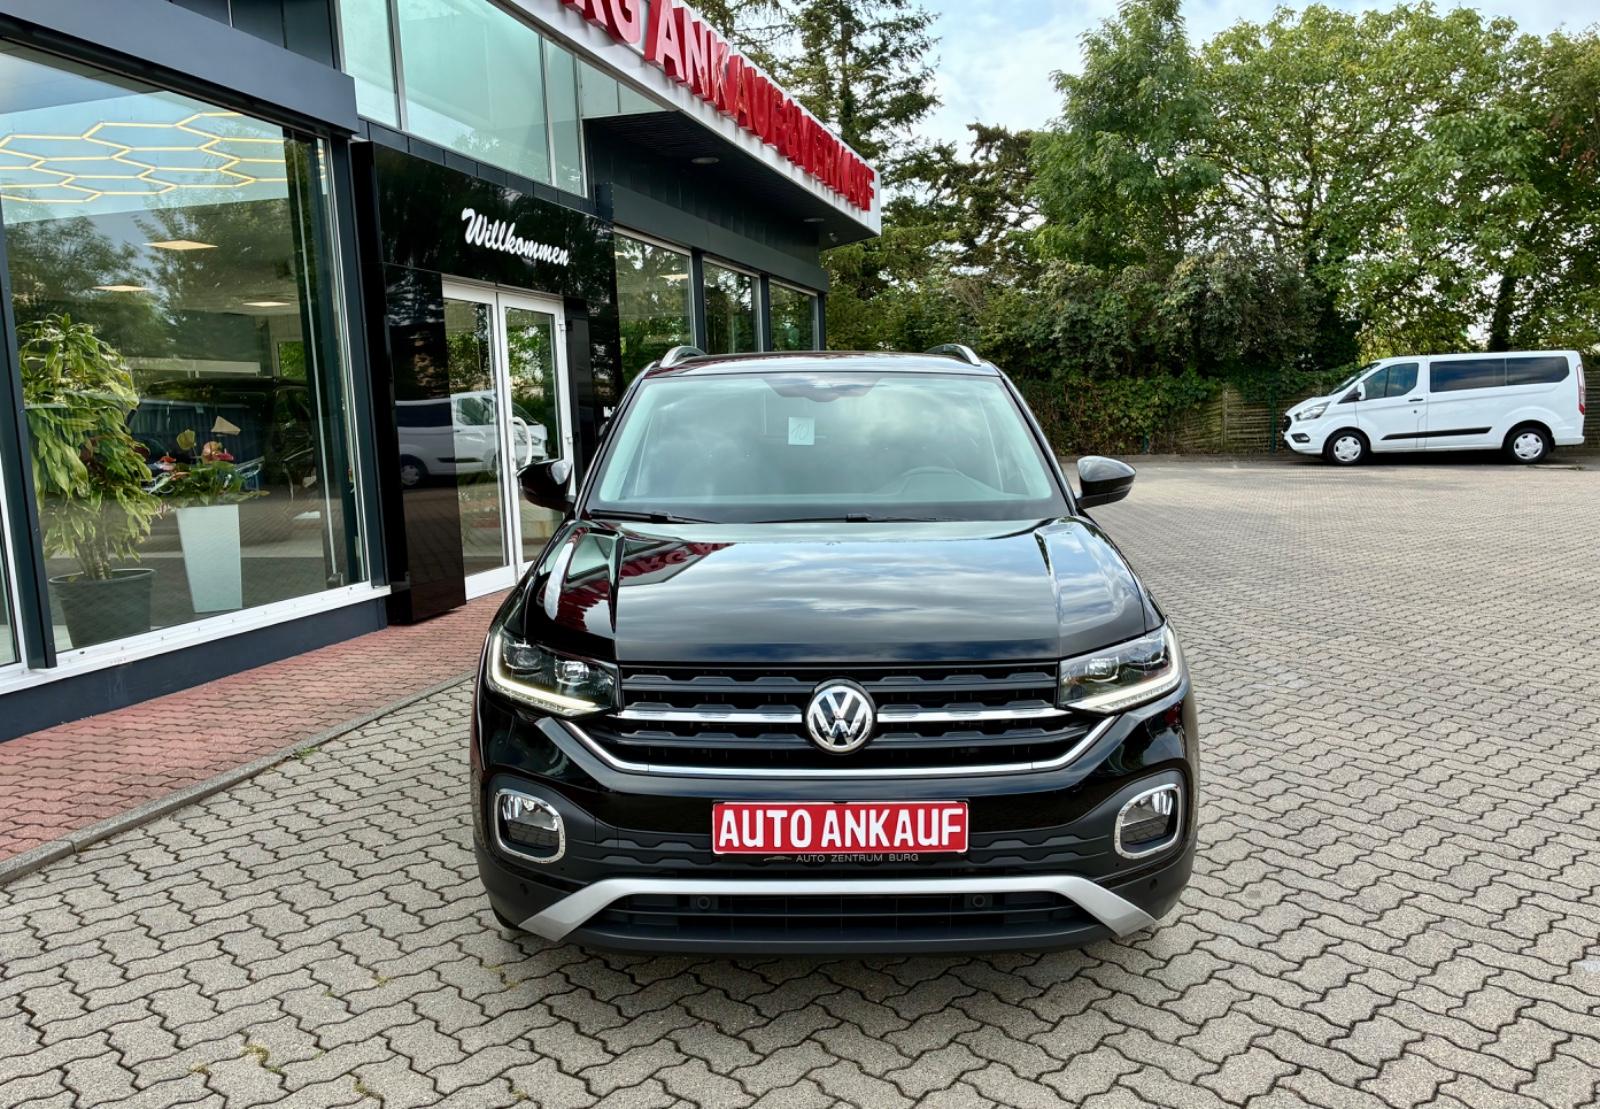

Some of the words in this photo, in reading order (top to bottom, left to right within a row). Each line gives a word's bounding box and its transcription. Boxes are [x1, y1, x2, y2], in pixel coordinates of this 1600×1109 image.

[645, 0, 784, 151] ANKAUF
[461, 207, 570, 267] Willkommen
[718, 808, 812, 848] AUTO
[820, 807, 964, 848] ANKAUF
[795, 854, 826, 863] AUTO
[830, 854, 883, 863] ZENTRUM
[888, 853, 919, 862] BURG
